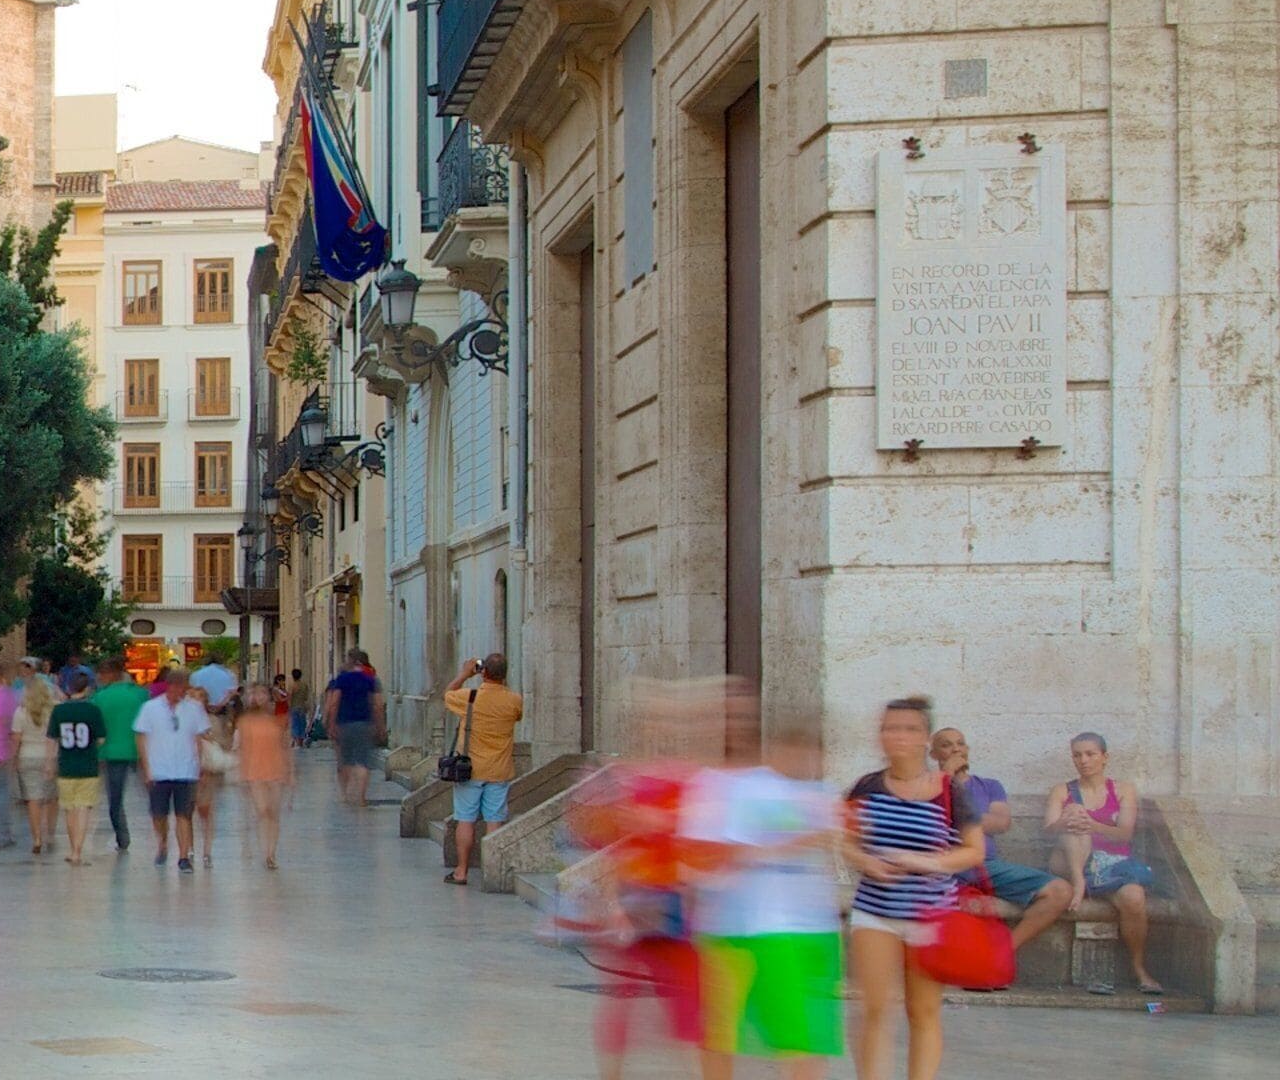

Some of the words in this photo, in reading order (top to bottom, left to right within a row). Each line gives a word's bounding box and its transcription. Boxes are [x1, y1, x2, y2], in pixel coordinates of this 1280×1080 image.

[892, 266, 914, 279] EN
[922, 264, 990, 278] RECORD
[998, 263, 1021, 275] DE
[1030, 262, 1052, 275] LA
[892, 281, 947, 295] VISITA
[953, 281, 965, 293] A
[969, 278, 1052, 293] VALENCIA
[1013, 295, 1052, 308] PAPA
[902, 315, 966, 336] JOAN
[1029, 313, 1041, 332] II
[892, 342, 911, 355] EL
[913, 341, 937, 354] VIII
[966, 338, 1051, 353] NOVEMBRE
[892, 373, 950, 387] ESSENT
[892, 421, 948, 436] RICARD
[989, 419, 1052, 433] CASADO
[59, 722, 90, 749] 59
